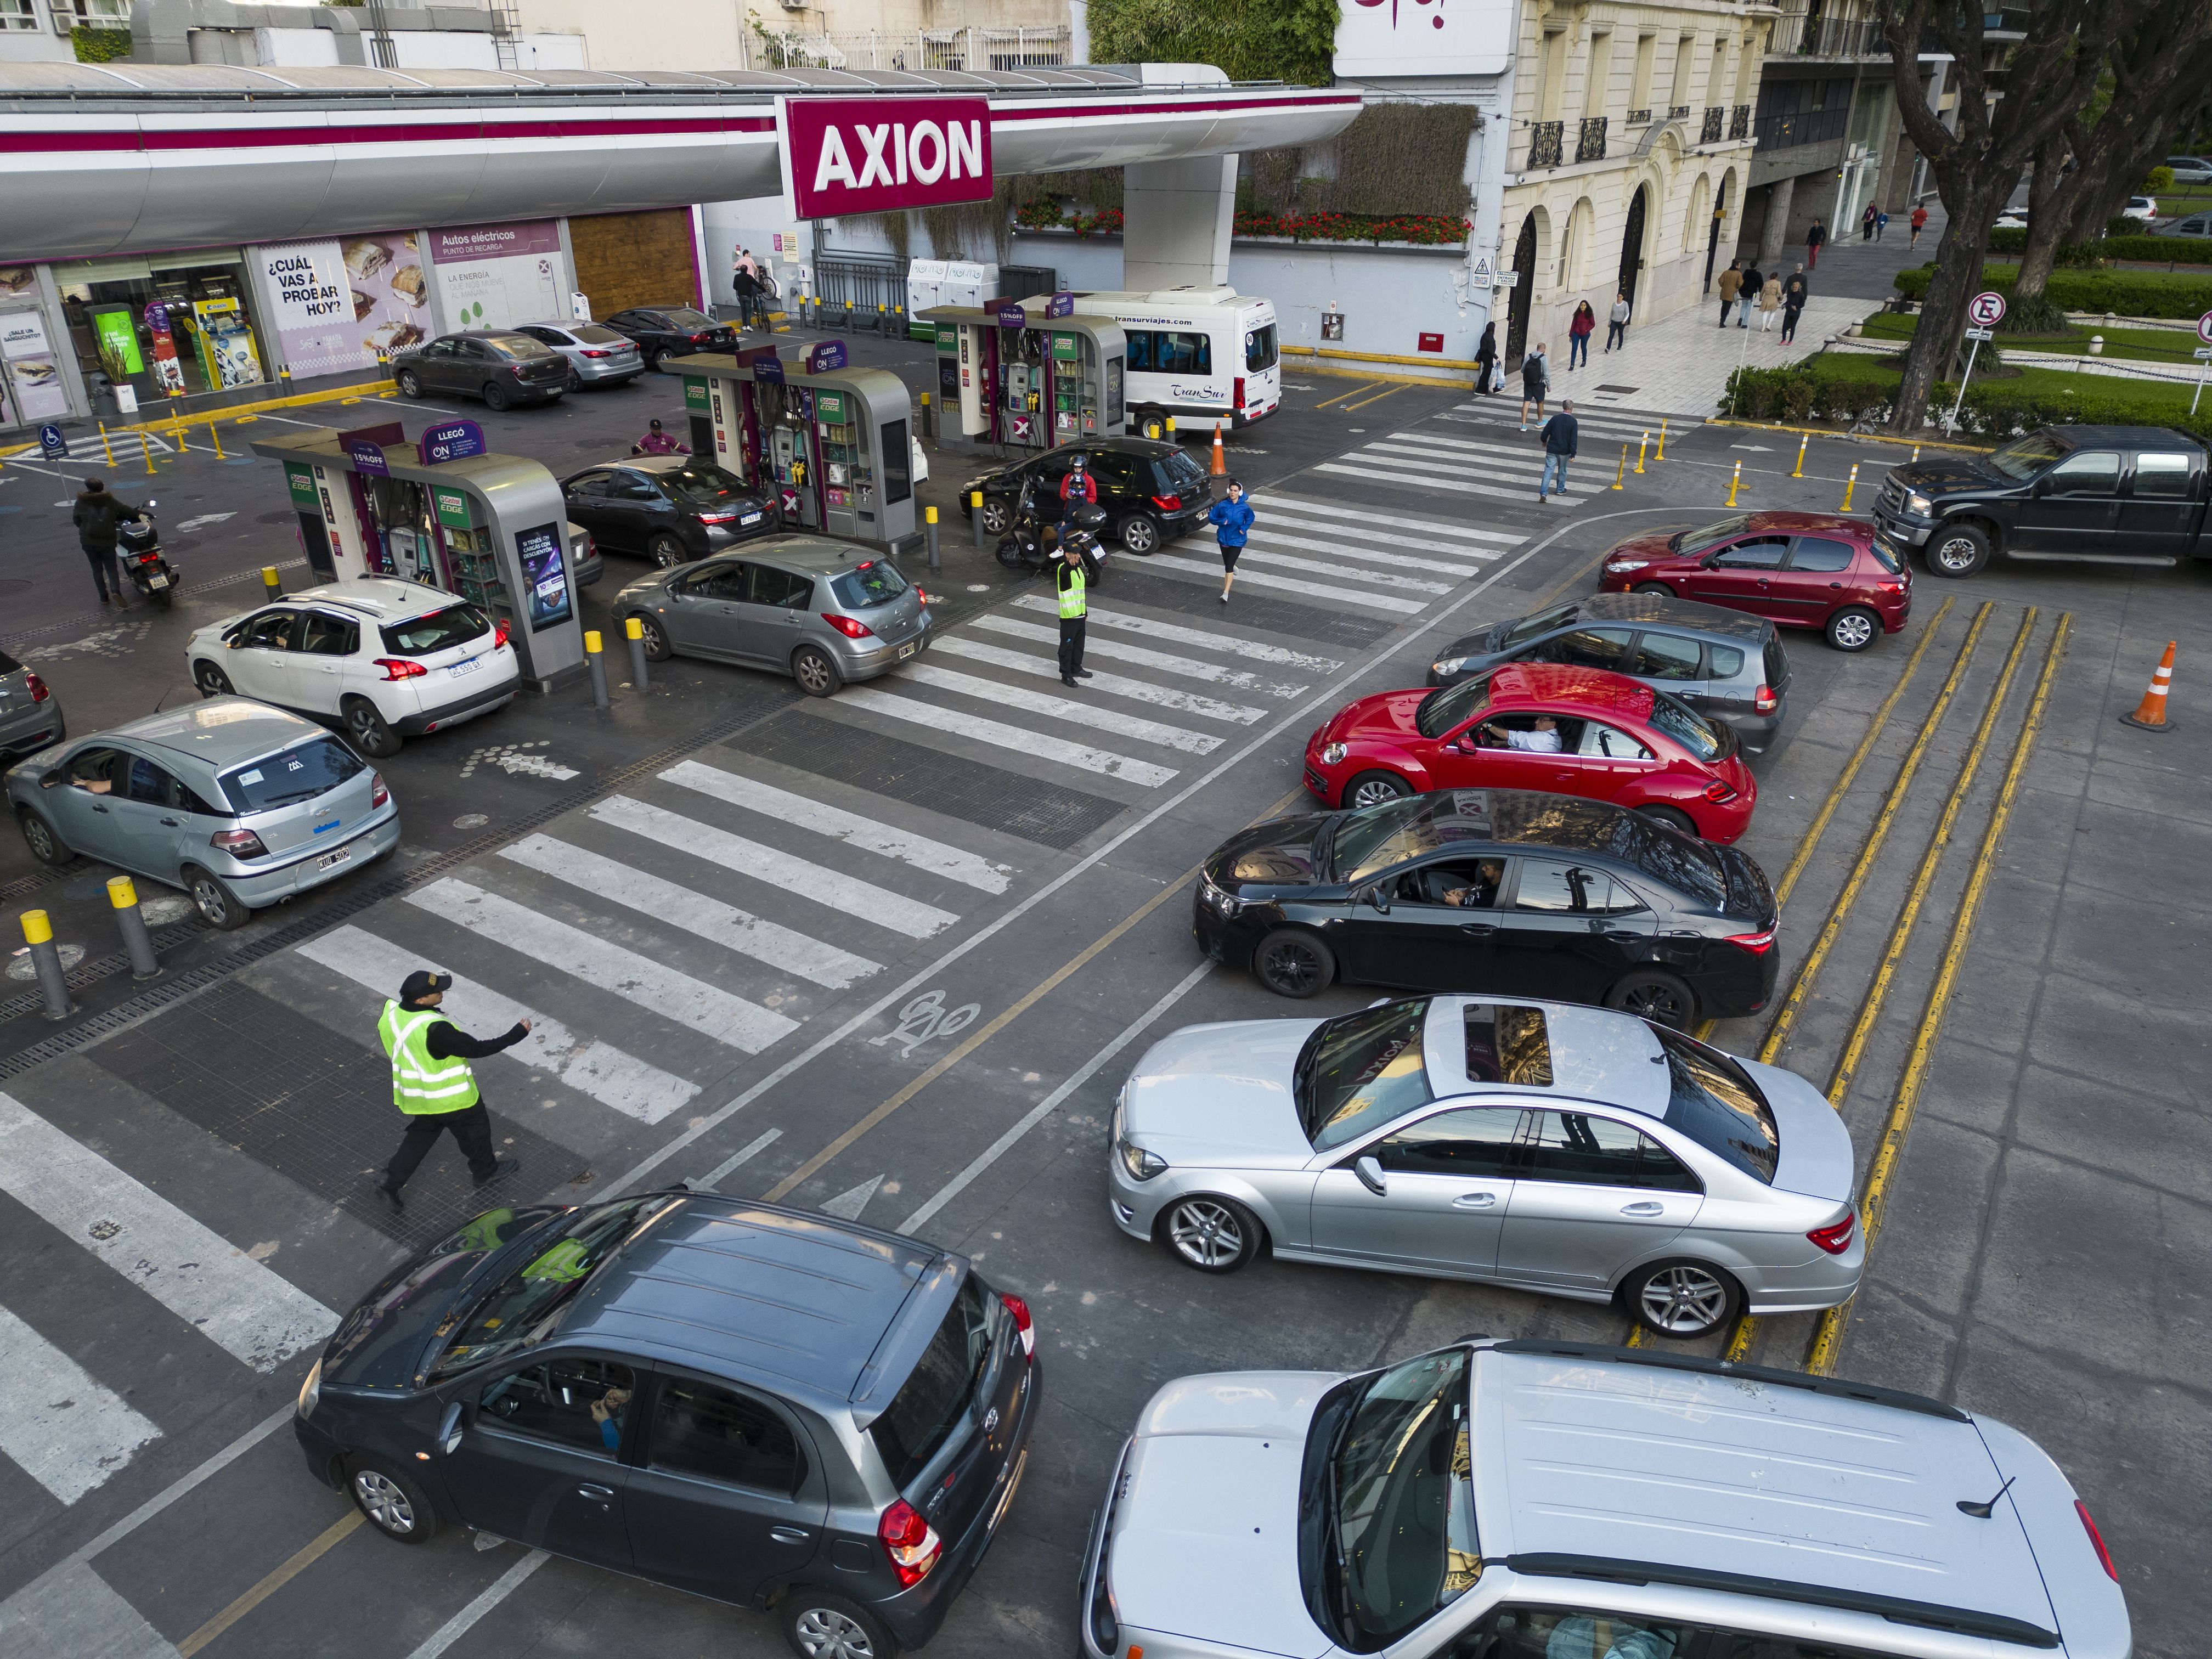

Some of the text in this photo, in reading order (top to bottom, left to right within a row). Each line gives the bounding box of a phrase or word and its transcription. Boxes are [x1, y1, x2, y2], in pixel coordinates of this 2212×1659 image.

[813, 119, 983, 192] AXION
[442, 230, 515, 246] Autos eléctricos
[443, 247, 464, 255] PUNTO
[475, 243, 503, 252] RECARGA
[269, 255, 312, 275] ¿CUÁL
[278, 273, 318, 287] VAS A
[460, 270, 489, 281] ENERGÍA
[449, 278, 504, 291] QUE NOS MUEVE
[282, 286, 338, 303] PROBAR
[306, 301, 341, 316] HOY?
[1978, 299, 1996, 319] E
[817, 359, 827, 368] ON
[438, 427, 465, 441] LLEGÓ
[433, 445, 449, 456] ON
[292, 483, 313, 492] EDGE
[441, 504, 463, 514] EDGE
[460, 664, 472, 672] 550
[319, 850, 348, 868] KUQ 502
